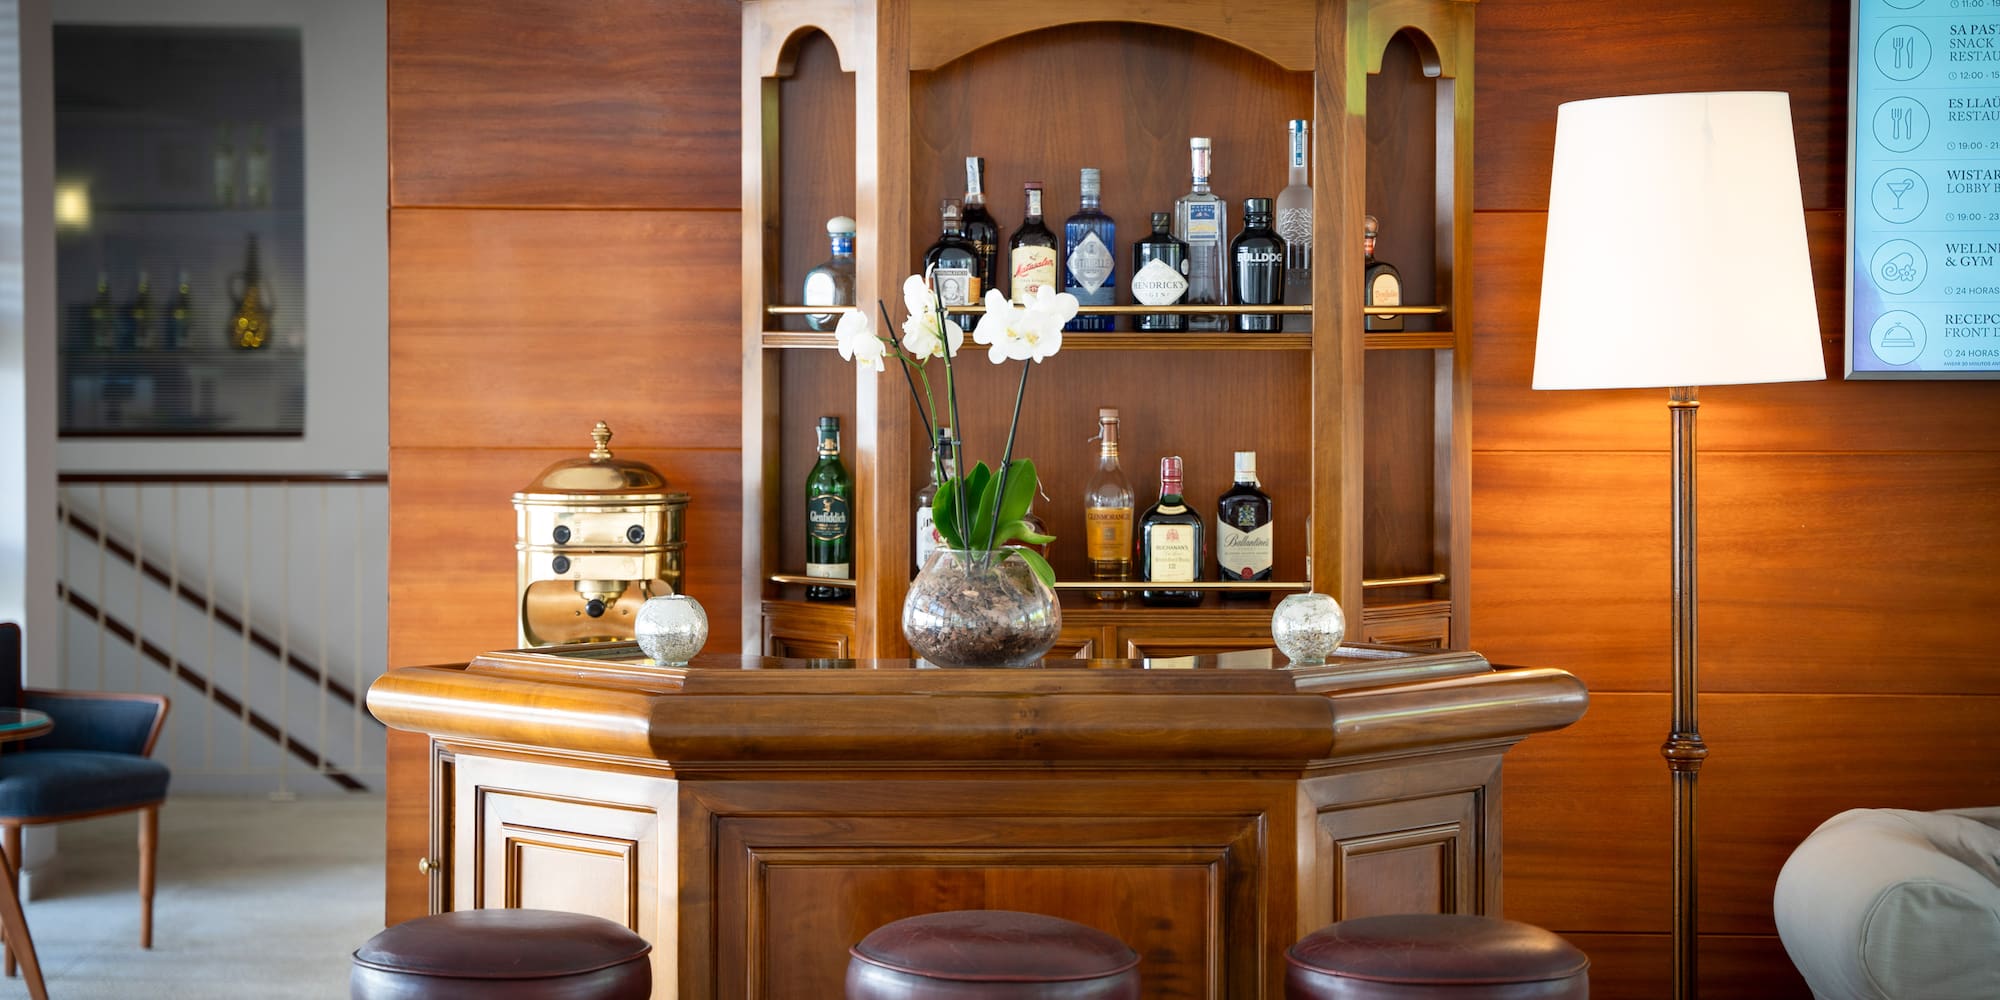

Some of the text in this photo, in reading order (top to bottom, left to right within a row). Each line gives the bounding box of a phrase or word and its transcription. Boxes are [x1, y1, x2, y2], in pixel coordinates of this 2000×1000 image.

[1950, 24, 1967, 35] SA
[1949, 38, 1994, 48] SNACK
[1950, 51, 2000, 61] RESTAU
[1949, 99, 1964, 108] ES
[1949, 111, 2000, 121] RESTAU
[1959, 142, 1983, 150] 19:00
[1947, 169, 2000, 180] WISTAR
[1947, 183, 1990, 193] LOBBY
[1958, 213, 1981, 221] 19:00
[1945, 243, 2000, 254] WELLN
[1237, 252, 1282, 262] BULLDOG
[1945, 256, 1993, 267] & GYM
[1956, 287, 2000, 295] 24 HORAS
[1945, 327, 1990, 337] FRONT
[1955, 349, 2000, 357] 24 HORAS
[810, 511, 847, 523] Glenfiddich
[1224, 533, 1270, 547] Ballantine's
